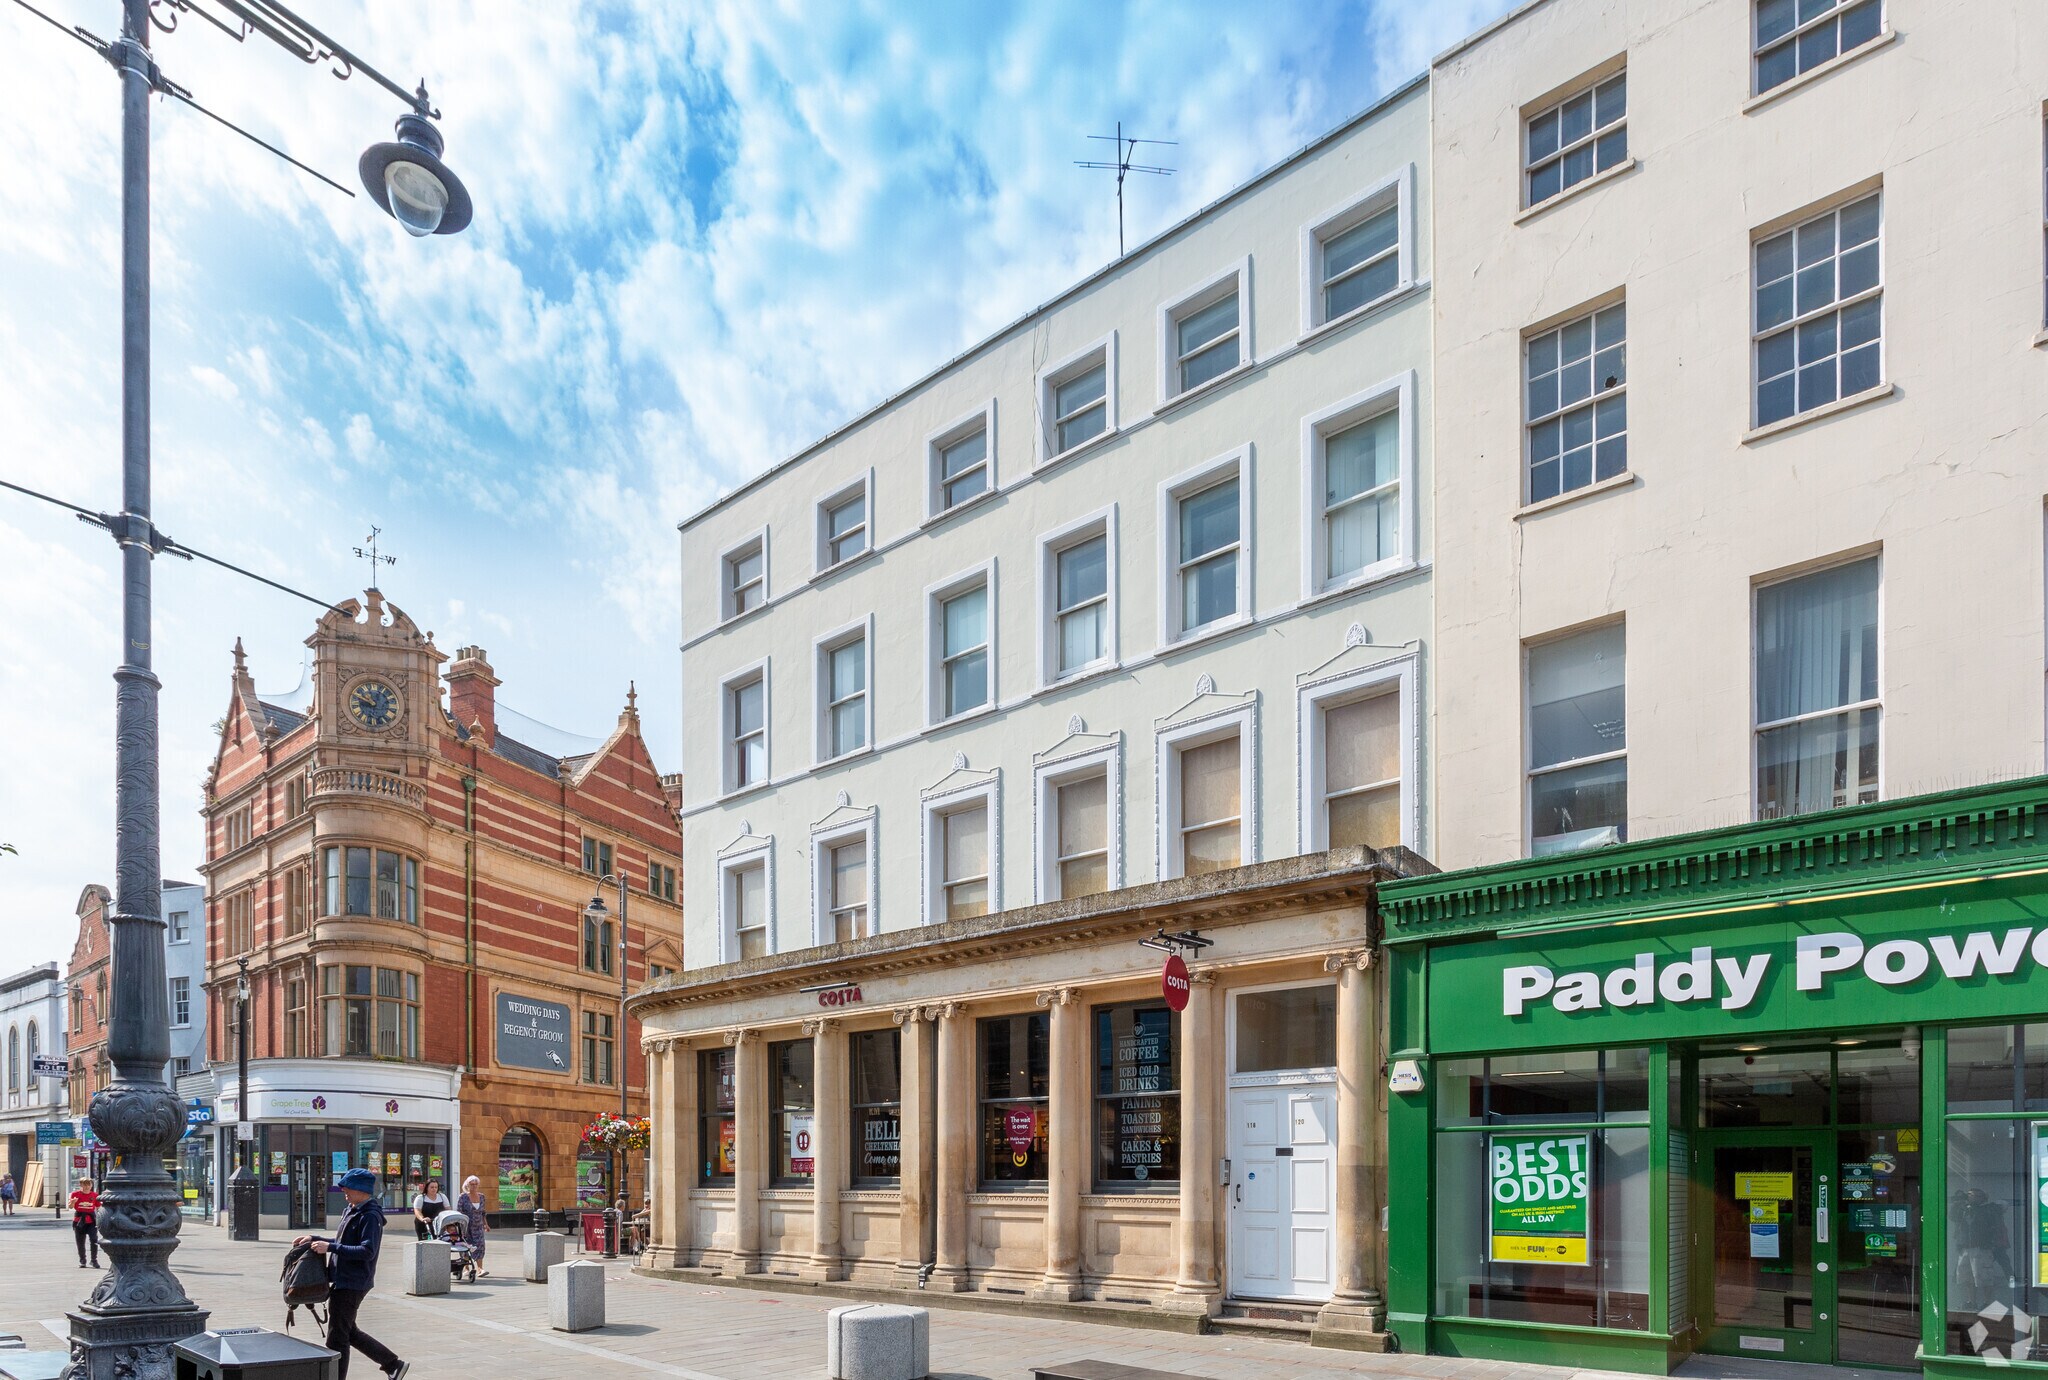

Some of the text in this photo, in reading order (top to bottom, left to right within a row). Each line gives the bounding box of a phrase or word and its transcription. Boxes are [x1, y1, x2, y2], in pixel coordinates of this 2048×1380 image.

[1167, 975, 1188, 990] COSTA
[1502, 945, 1771, 1016] Paddy
[819, 986, 862, 1007] COSTA
[508, 1001, 560, 1020] WEDDING DAYS
[531, 1018, 537, 1028] &
[504, 1024, 563, 1043] REGENCY GROOM
[1120, 1038, 1158, 1047] HANDCRAFTED
[1119, 1046, 1159, 1061] COFFEE
[1120, 1065, 1159, 1077] ICED COLD
[1120, 1076, 1159, 1091] DRINKS
[1121, 1097, 1161, 1109] PANINIS
[188, 1110, 210, 1120] sta
[1121, 1112, 1161, 1124] TOASTED
[864, 1120, 900, 1141] HELL
[1121, 1125, 1161, 1134] SANDWICHES
[865, 1141, 901, 1151] CHELTENHA
[1122, 1140, 1162, 1152] CAKES &
[864, 1152, 898, 1164] Come on
[1122, 1153, 1161, 1163] PASTRIES
[1493, 1137, 1586, 1178] BEST
[1493, 1171, 1586, 1203] ODDS
